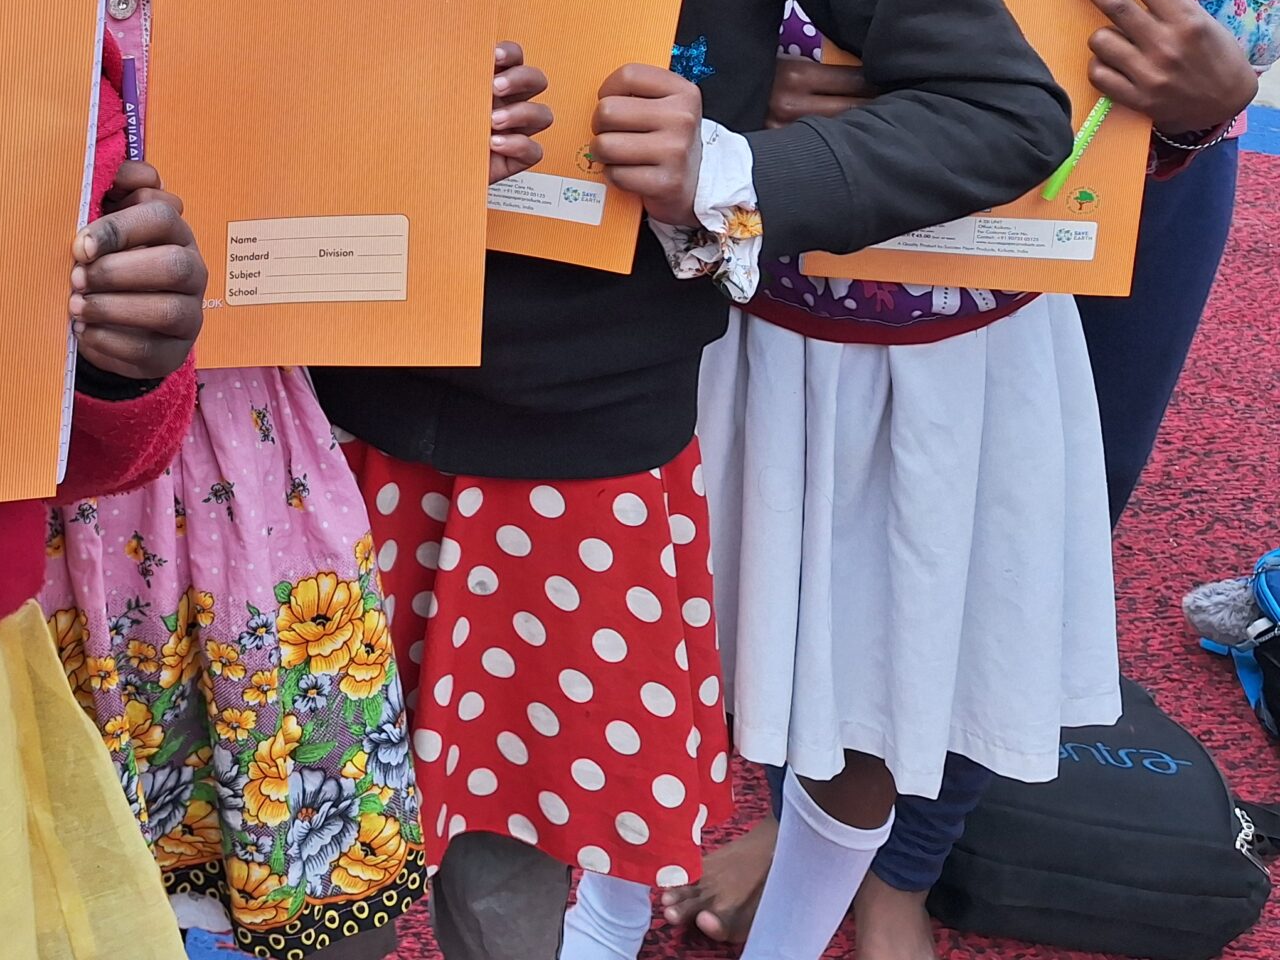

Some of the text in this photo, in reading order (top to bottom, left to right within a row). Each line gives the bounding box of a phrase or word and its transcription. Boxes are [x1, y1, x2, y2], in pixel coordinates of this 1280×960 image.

[230, 236, 258, 245] Name
[230, 248, 354, 262] Standard Division
[229, 270, 261, 280] Subject
[228, 288, 258, 298] School
